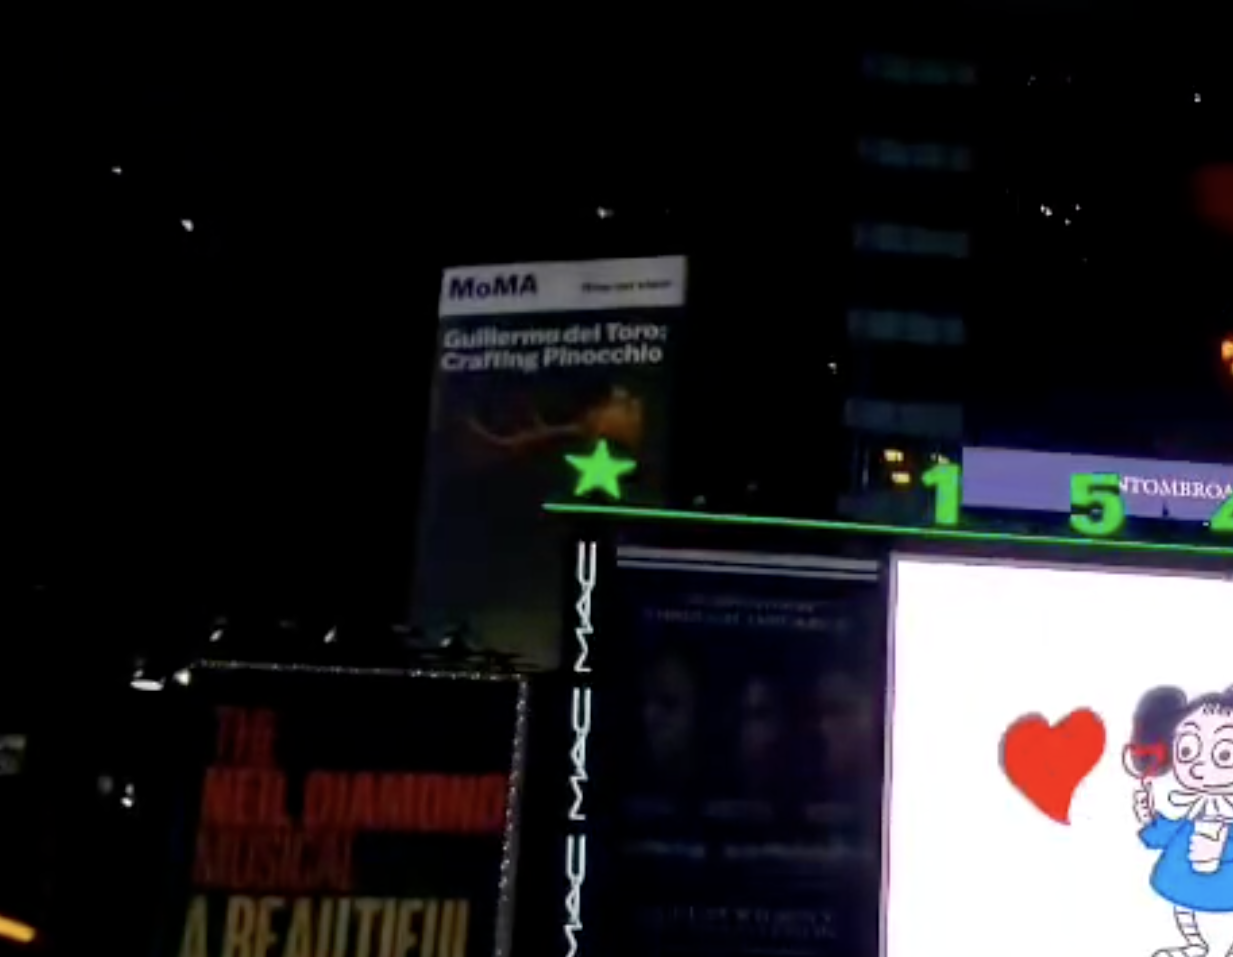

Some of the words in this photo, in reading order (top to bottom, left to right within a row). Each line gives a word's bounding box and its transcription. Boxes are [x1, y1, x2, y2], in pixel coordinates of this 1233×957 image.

[450, 274, 537, 299] MoMA
[442, 325, 560, 350] Guillermo
[562, 322, 600, 344] del
[603, 319, 668, 344] Toro:
[439, 348, 540, 375] Crafting
[543, 343, 664, 368] Pinocchio
